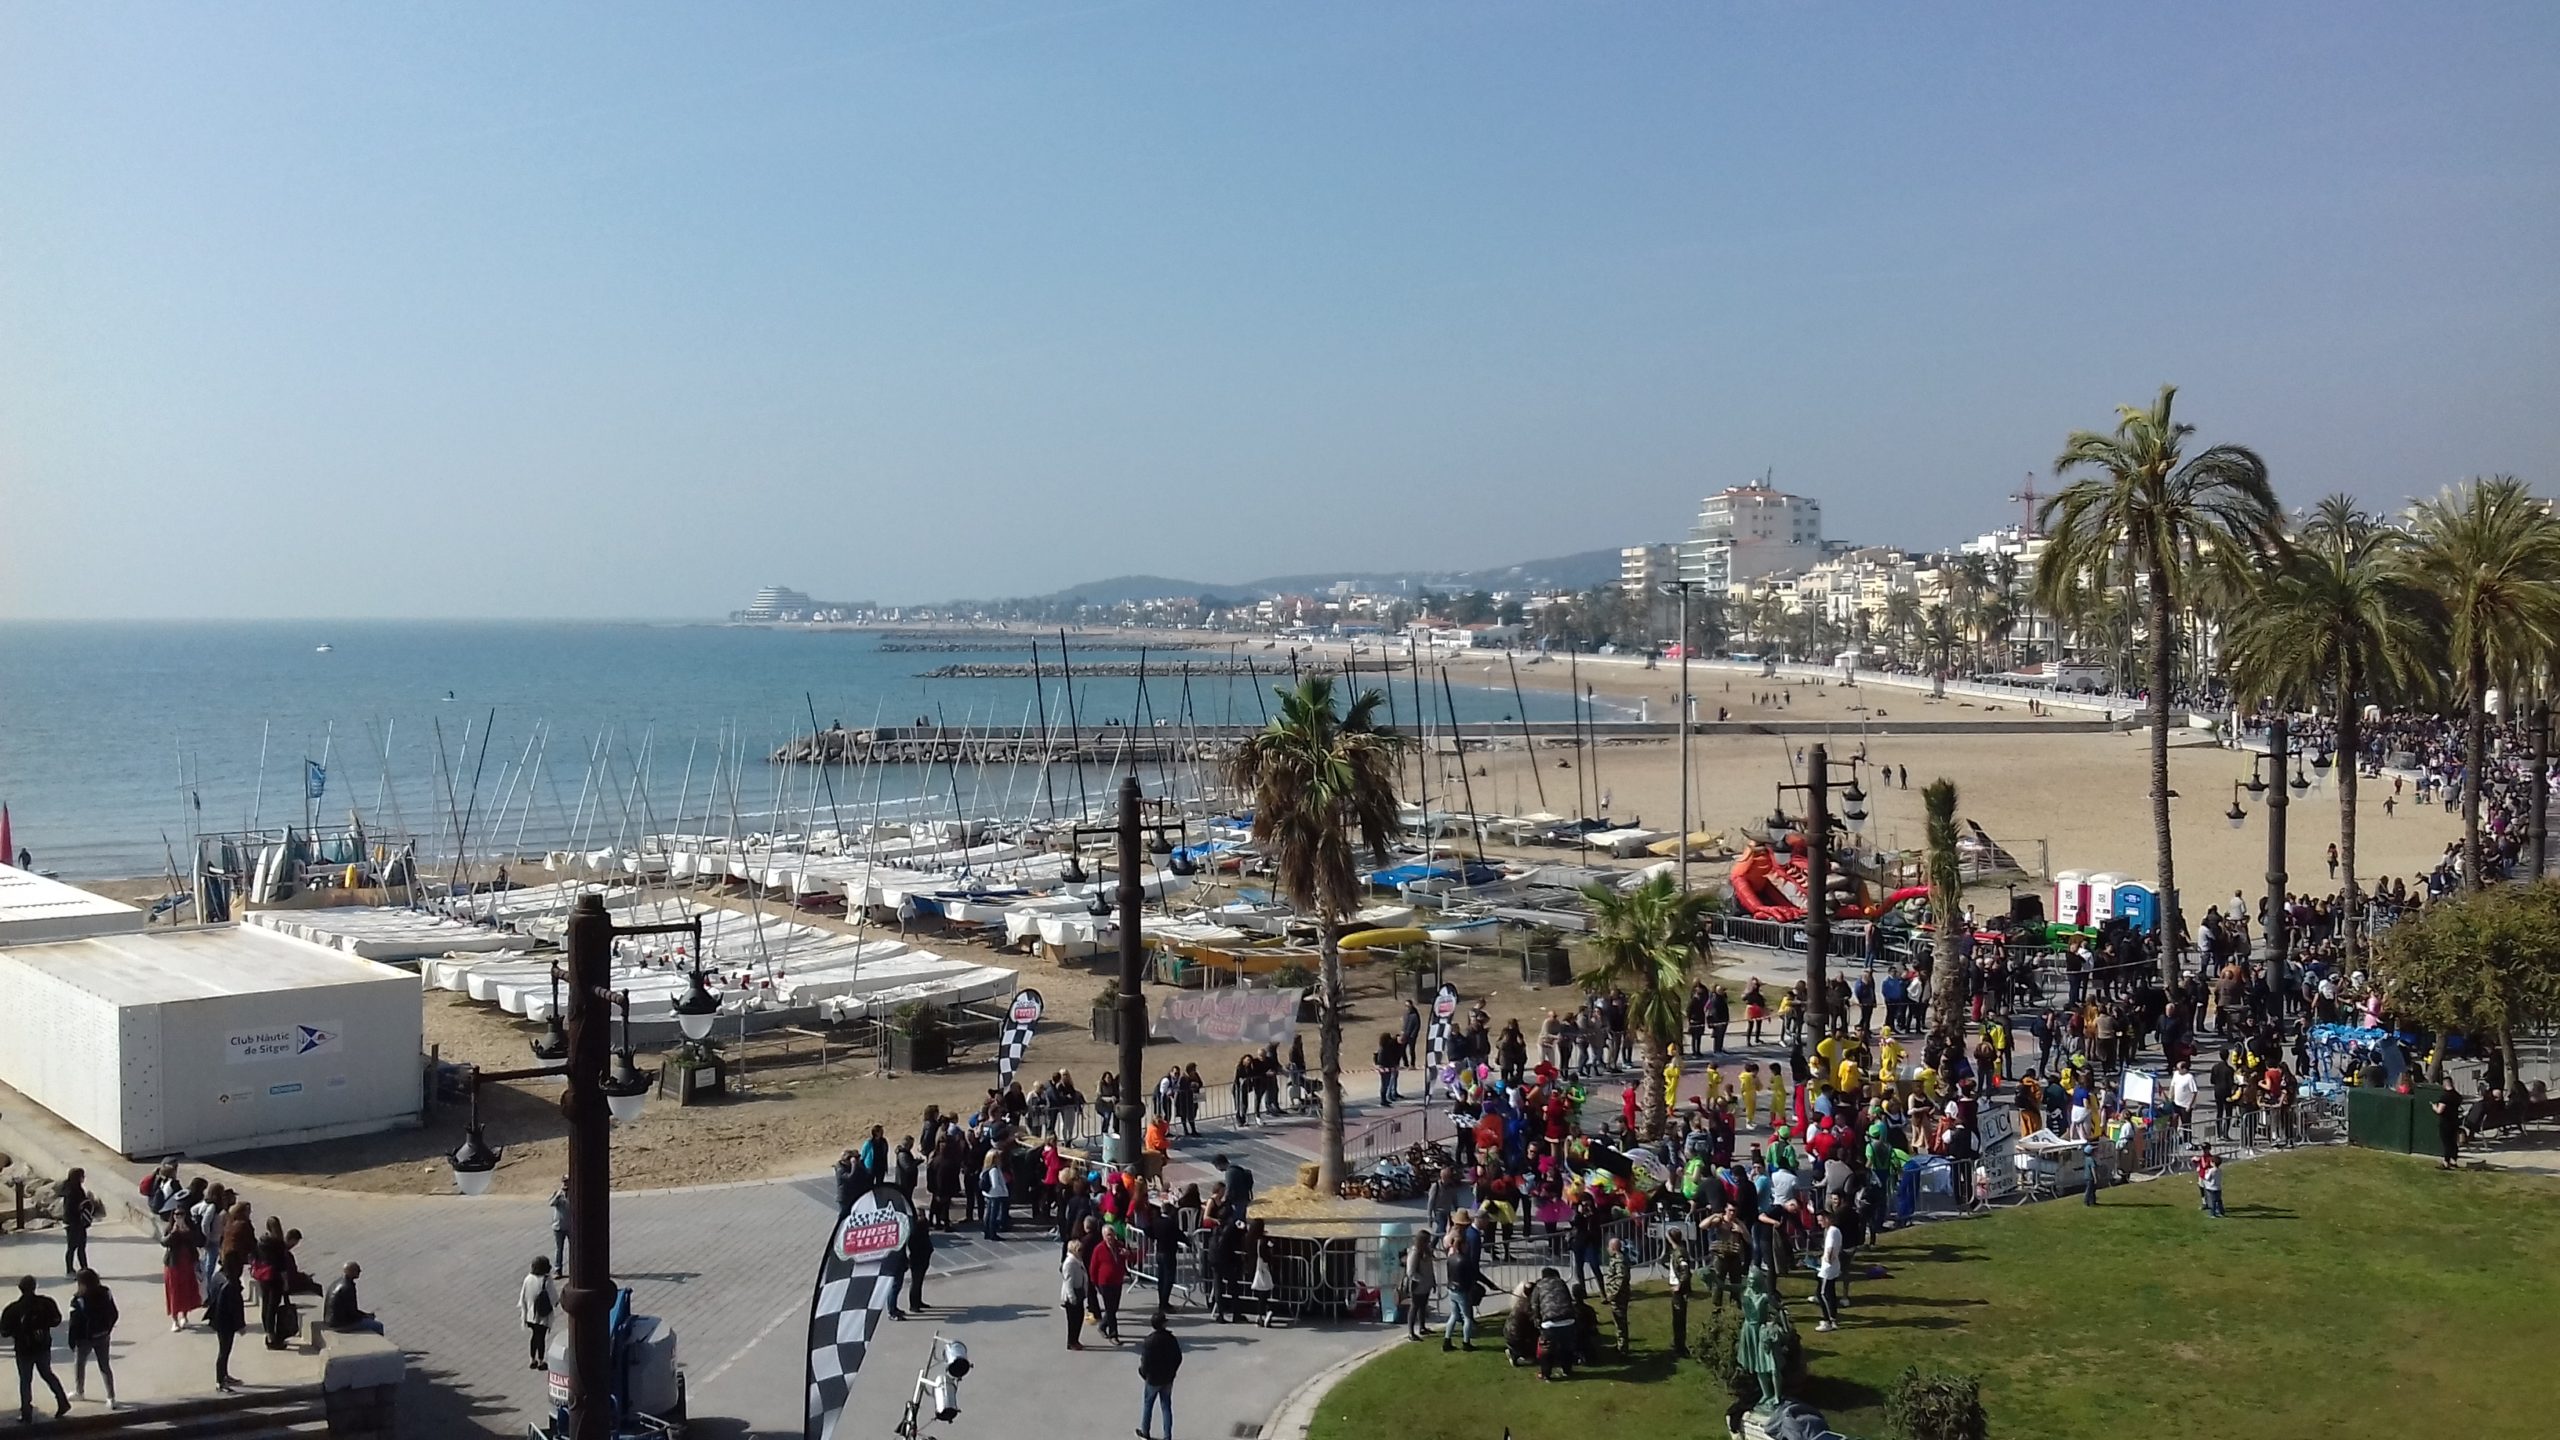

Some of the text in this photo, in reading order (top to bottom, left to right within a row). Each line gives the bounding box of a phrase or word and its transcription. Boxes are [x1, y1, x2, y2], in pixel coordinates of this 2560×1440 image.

[230, 1034, 254, 1046] Club
[244, 1044, 290, 1055] de Sitges
